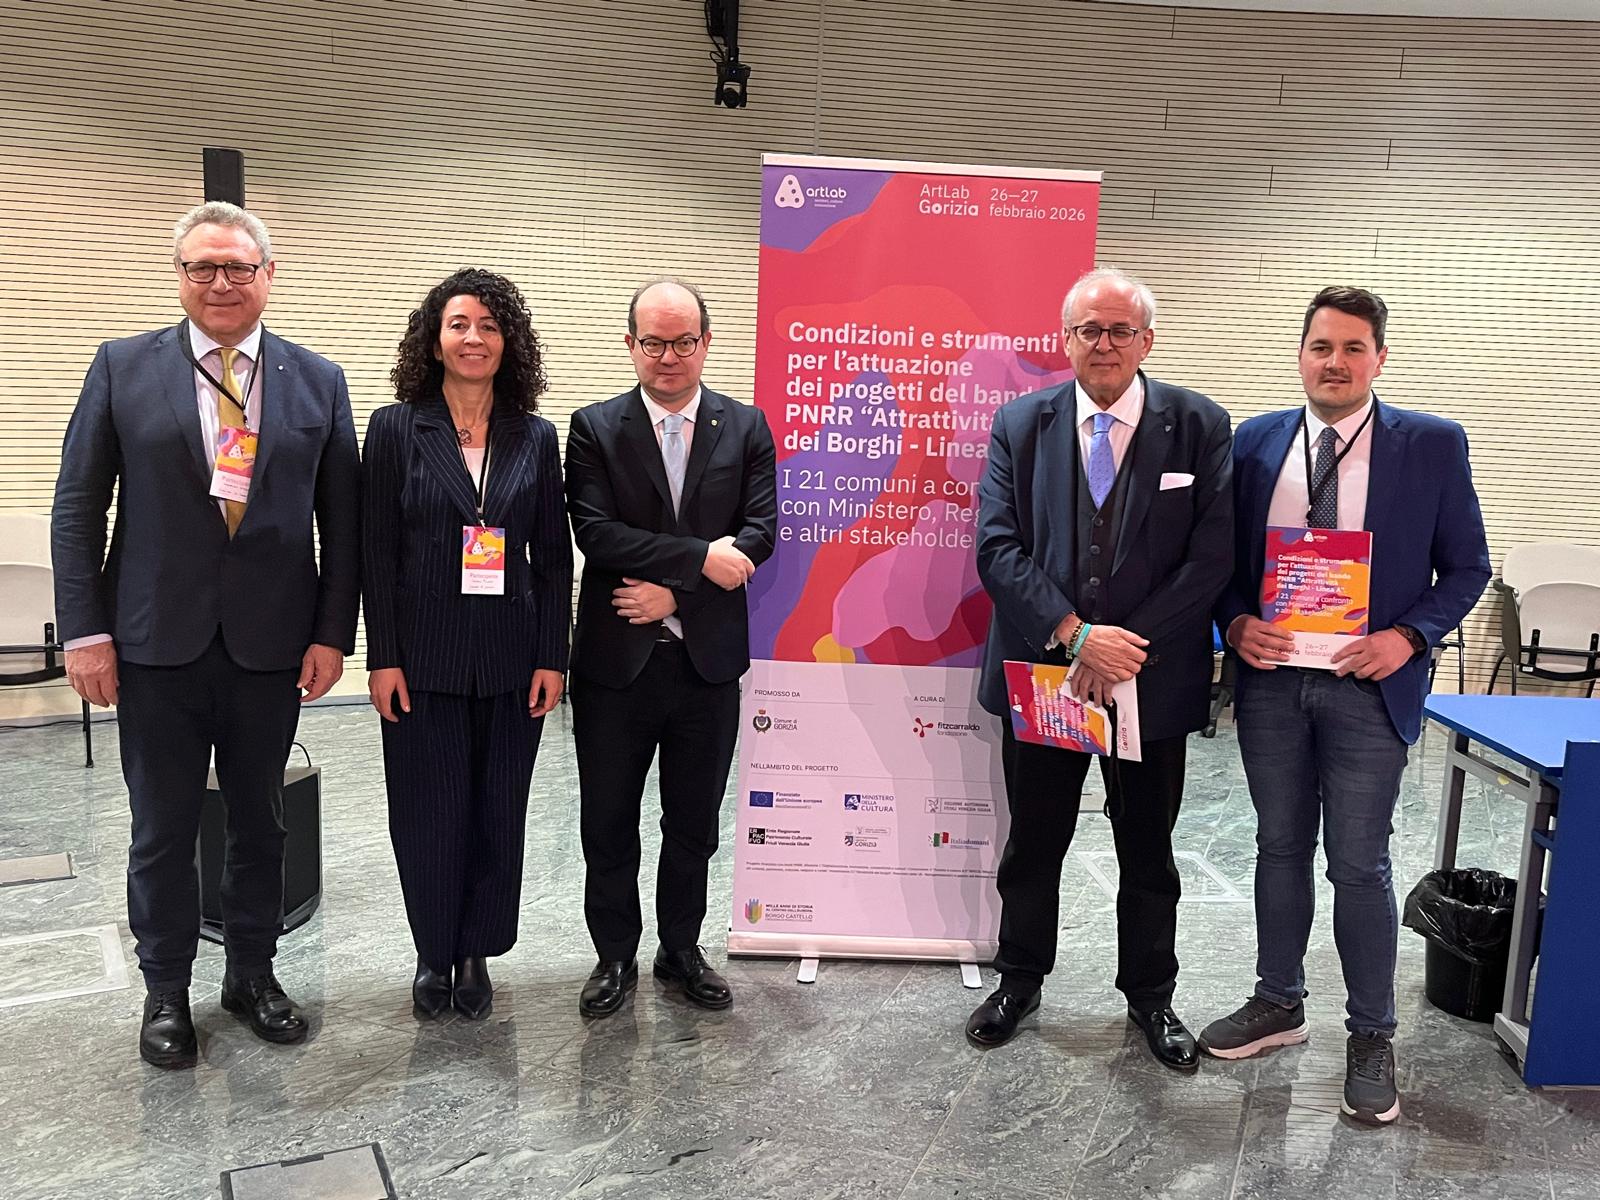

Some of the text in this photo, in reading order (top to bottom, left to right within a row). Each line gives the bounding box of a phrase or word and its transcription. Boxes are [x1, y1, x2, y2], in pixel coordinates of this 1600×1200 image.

[806, 186, 846, 198] artlab
[920, 184, 970, 199] ArtLab
[919, 200, 979, 216] Gorizia
[989, 203, 1086, 221] febbraio 2026
[788, 322, 1058, 353] Condizioni e strumenti
[788, 353, 827, 374] per
[786, 376, 822, 397] dei
[829, 381, 923, 405] progetti
[930, 382, 966, 403] del
[785, 404, 996, 431] PNRR “Attrattivit
[784, 430, 820, 452] dei
[827, 432, 902, 459] Borghi
[926, 436, 989, 459] Linea
[782, 469, 792, 488] I
[799, 470, 827, 490] 21
[834, 474, 917, 494] comuni
[923, 479, 936, 495] a
[781, 500, 820, 516] con
[828, 498, 937, 524] Ministero,
[780, 522, 977, 549] e altri stakeholde
[1278, 554, 1313, 563] Condizioni
[938, 722, 980, 731] fitzcarraldo
